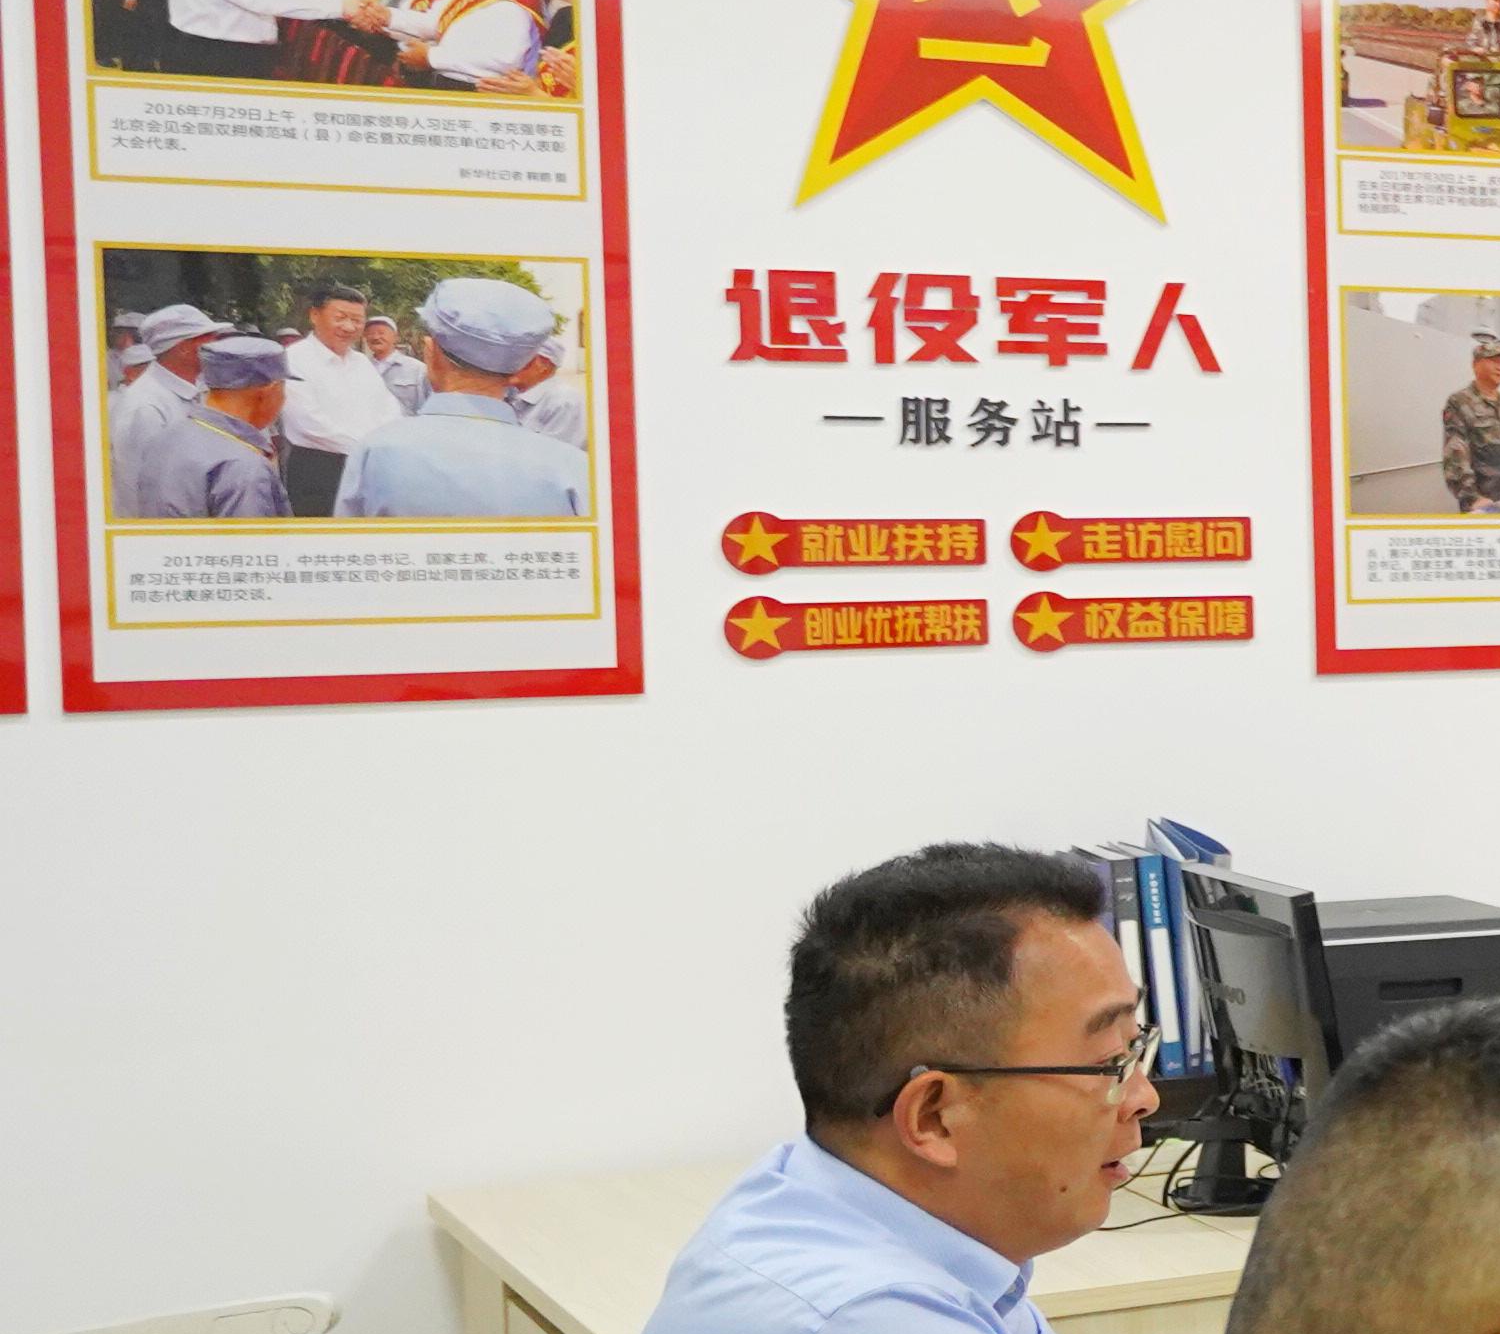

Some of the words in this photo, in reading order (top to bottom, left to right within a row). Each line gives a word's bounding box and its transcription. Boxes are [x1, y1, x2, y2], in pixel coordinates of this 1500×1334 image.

[724, 269, 1222, 373] 退役军人
[899, 396, 1083, 447] 服务站
[802, 523, 981, 563] 就业扶持
[1082, 521, 1245, 561] 走访慰问
[804, 605, 982, 645] 创业优抚帮扶
[1085, 600, 1248, 641] 权益保障
